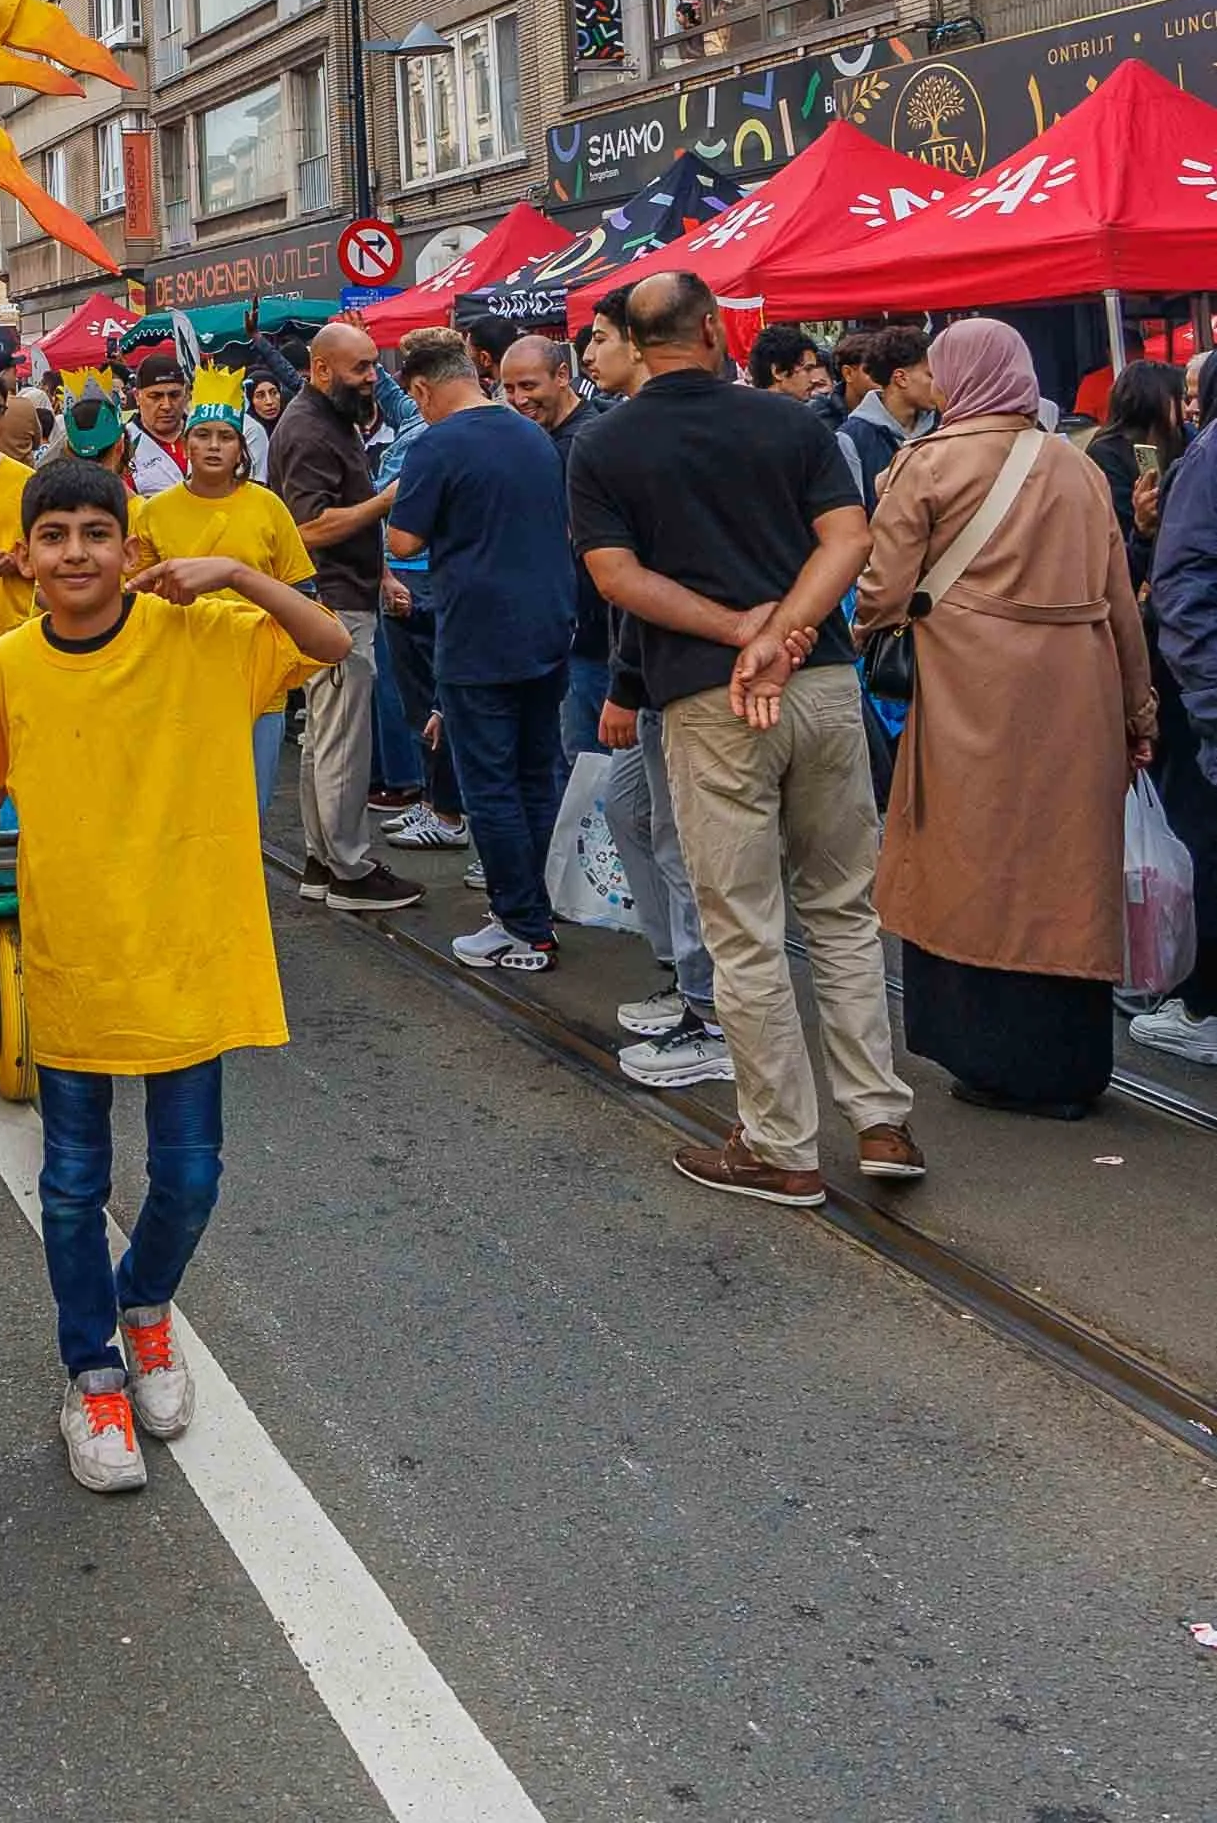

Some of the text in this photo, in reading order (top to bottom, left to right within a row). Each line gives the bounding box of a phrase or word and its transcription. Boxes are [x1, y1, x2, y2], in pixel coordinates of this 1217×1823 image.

[1048, 10, 1217, 65] ONTBIJT LUNC
[588, 120, 664, 167] SAAMO
[155, 241, 332, 307] DE SCHOENEN OUTLET
[200, 403, 225, 418] 314
